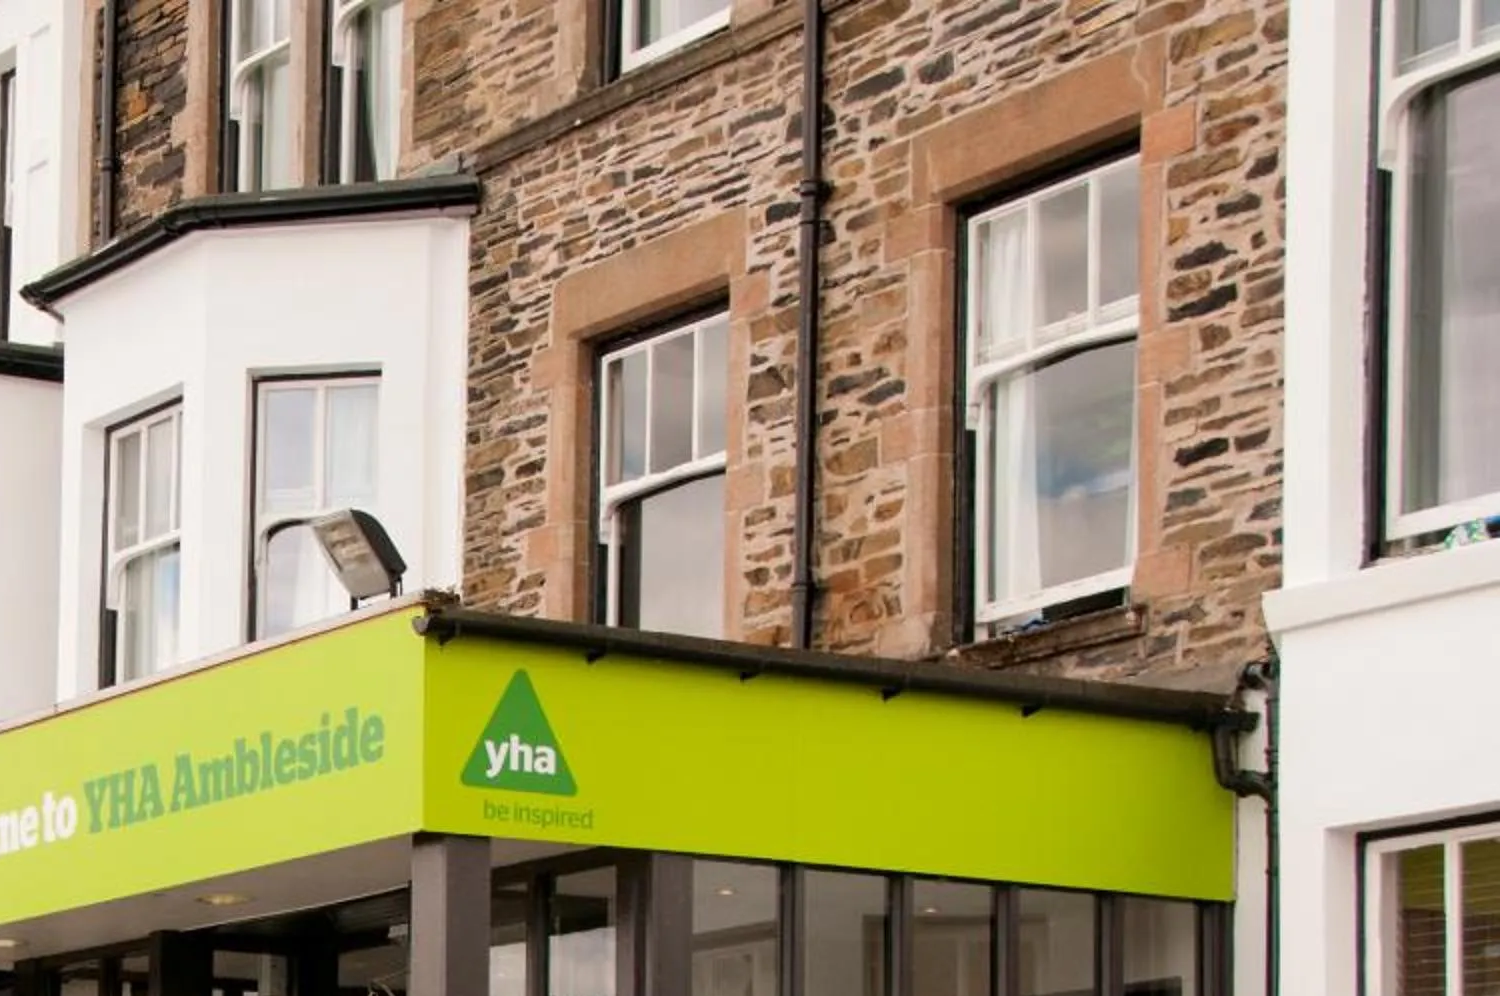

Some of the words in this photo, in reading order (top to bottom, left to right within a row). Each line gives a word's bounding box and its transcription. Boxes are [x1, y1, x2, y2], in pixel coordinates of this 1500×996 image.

[41, 792, 78, 843] to
[83, 764, 164, 834] YHA
[170, 706, 385, 813] Ambleside
[484, 733, 557, 779] yha
[483, 800, 509, 822] be
[513, 802, 594, 830] inspired
